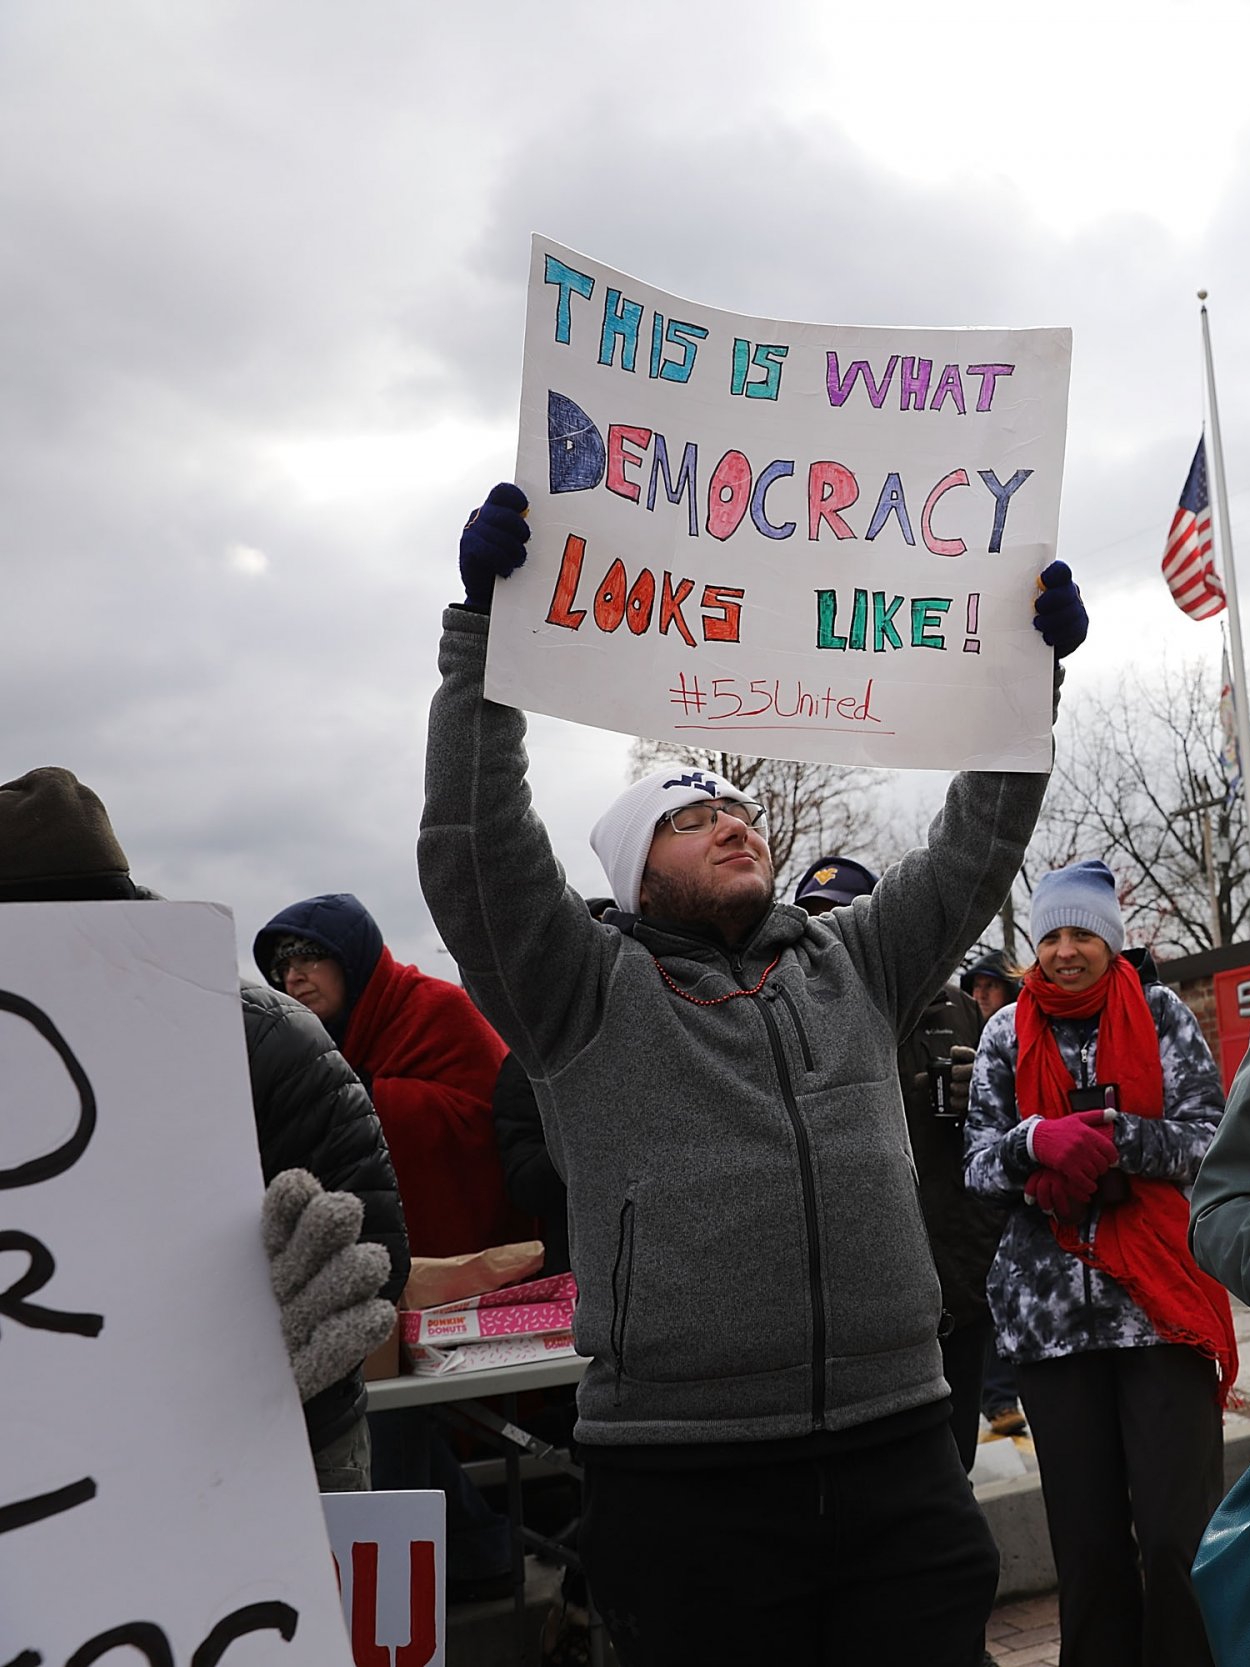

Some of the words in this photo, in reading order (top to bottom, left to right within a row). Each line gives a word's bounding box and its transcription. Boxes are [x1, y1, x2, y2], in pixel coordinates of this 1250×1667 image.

[544, 253, 709, 383] THIS
[730, 337, 790, 401] IS
[825, 350, 1015, 415] WHAT
[547, 388, 1035, 557] DEMOCRACY
[544, 533, 745, 648] LOOKS
[814, 588, 981, 655] LIKE!
[669, 672, 882, 724] #55United
